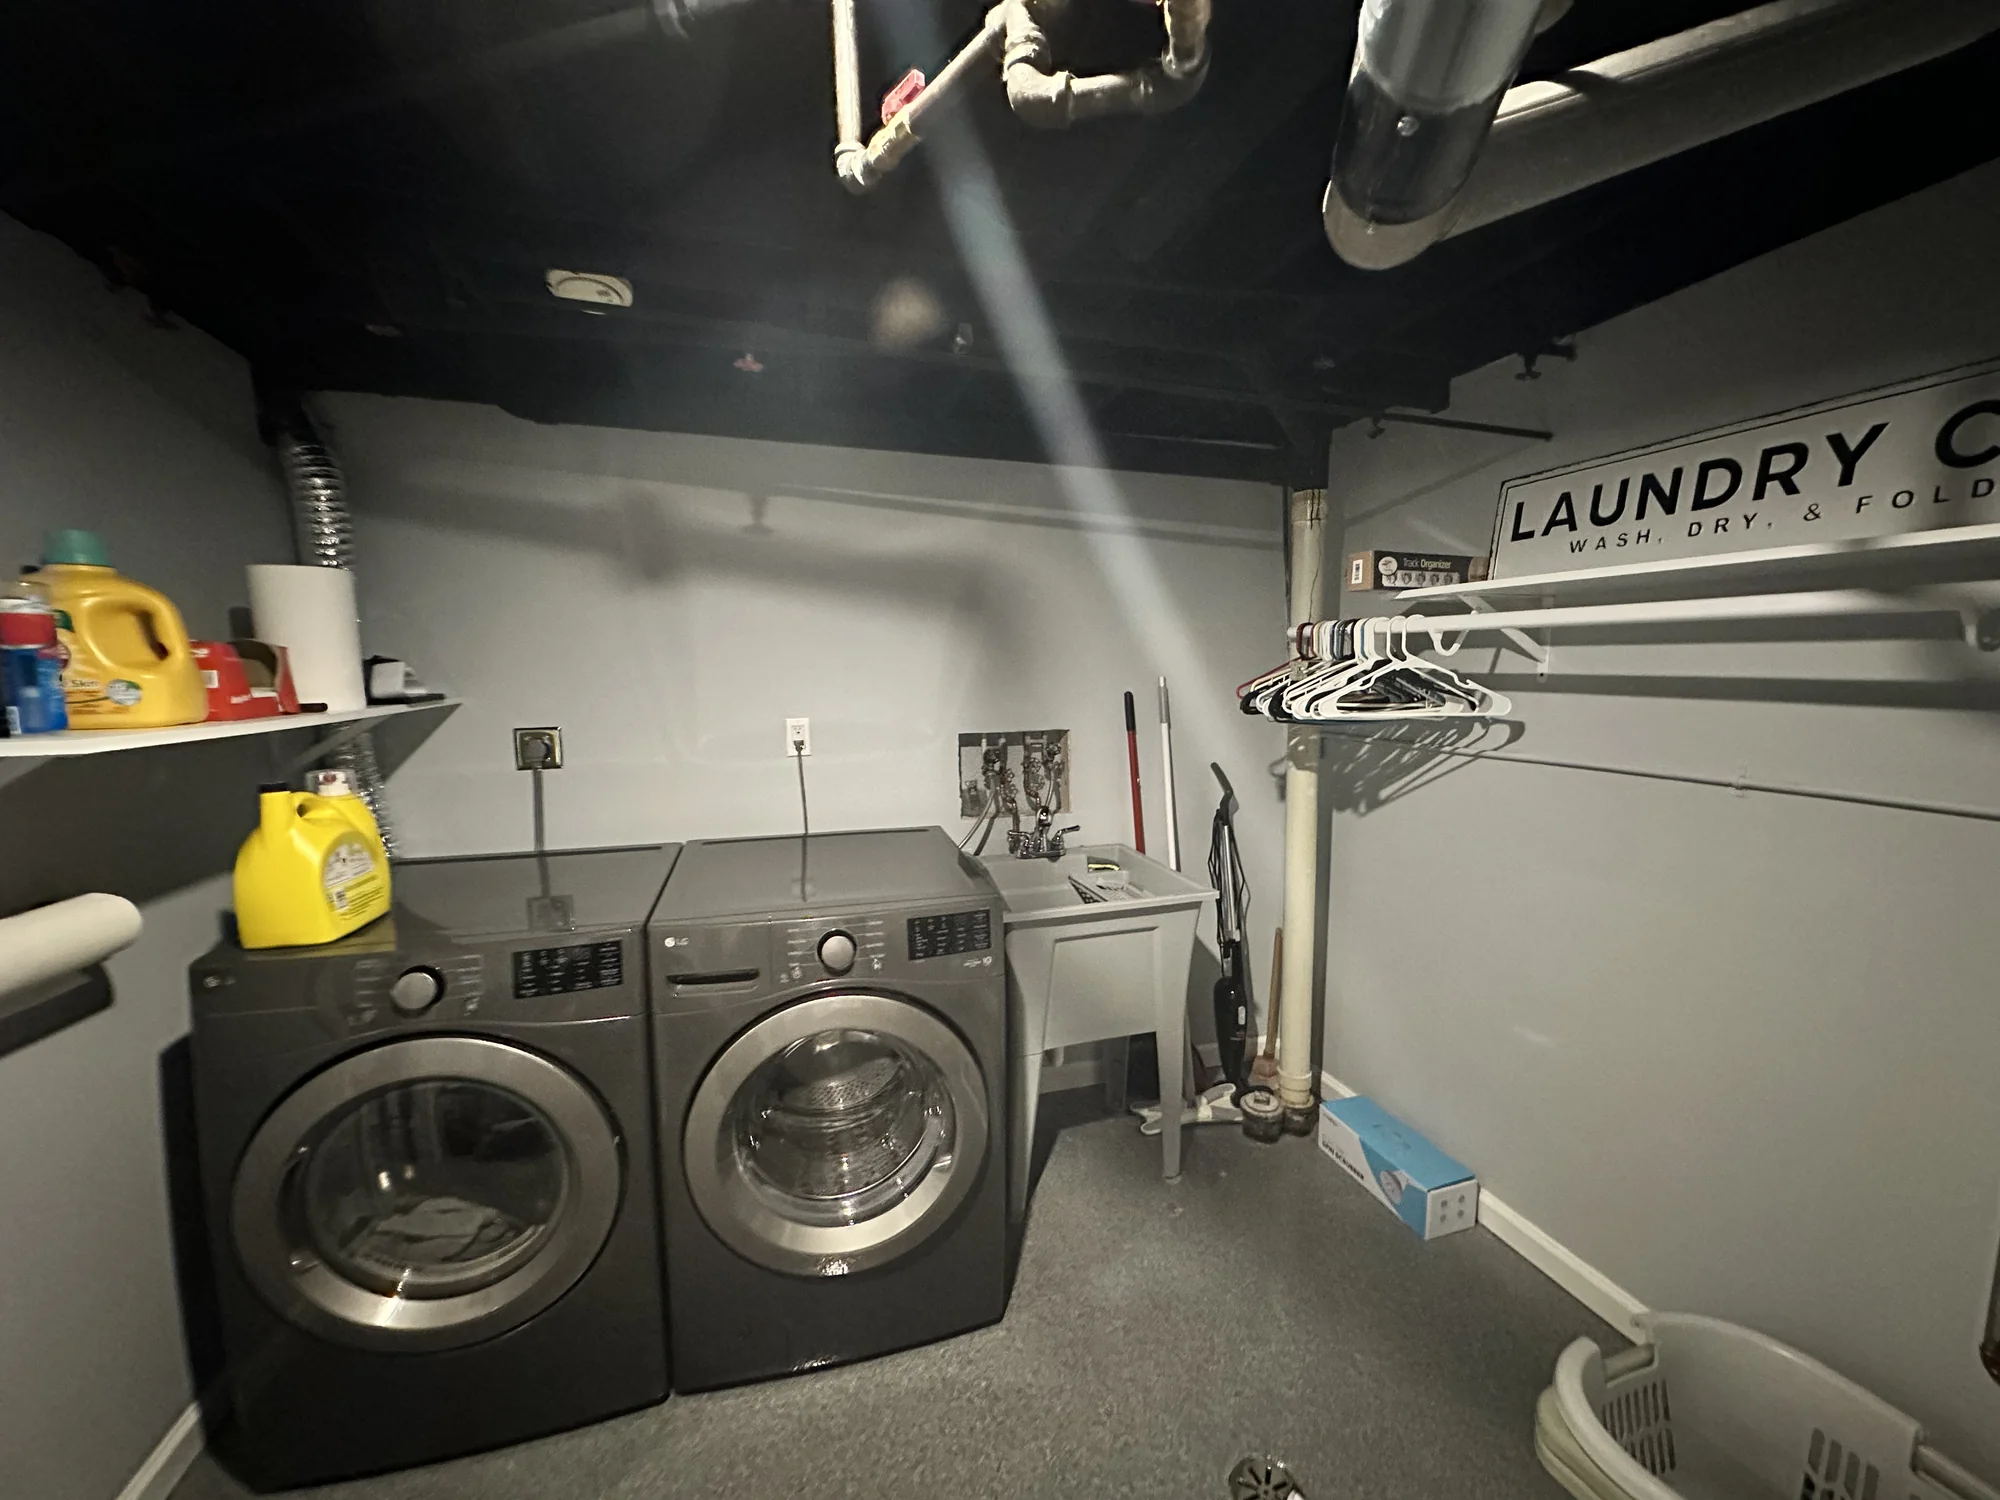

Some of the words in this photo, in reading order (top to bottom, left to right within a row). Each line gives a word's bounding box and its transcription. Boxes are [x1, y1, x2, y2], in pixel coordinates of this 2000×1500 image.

[1510, 421, 1891, 541] LAUNDRY
[1688, 512, 1774, 538] DRY,
[1803, 502, 1822, 522] &
[1856, 478, 1996, 514] FOLD
[1402, 557, 1420, 568] Track
[1420, 559, 1452, 570] Organizer
